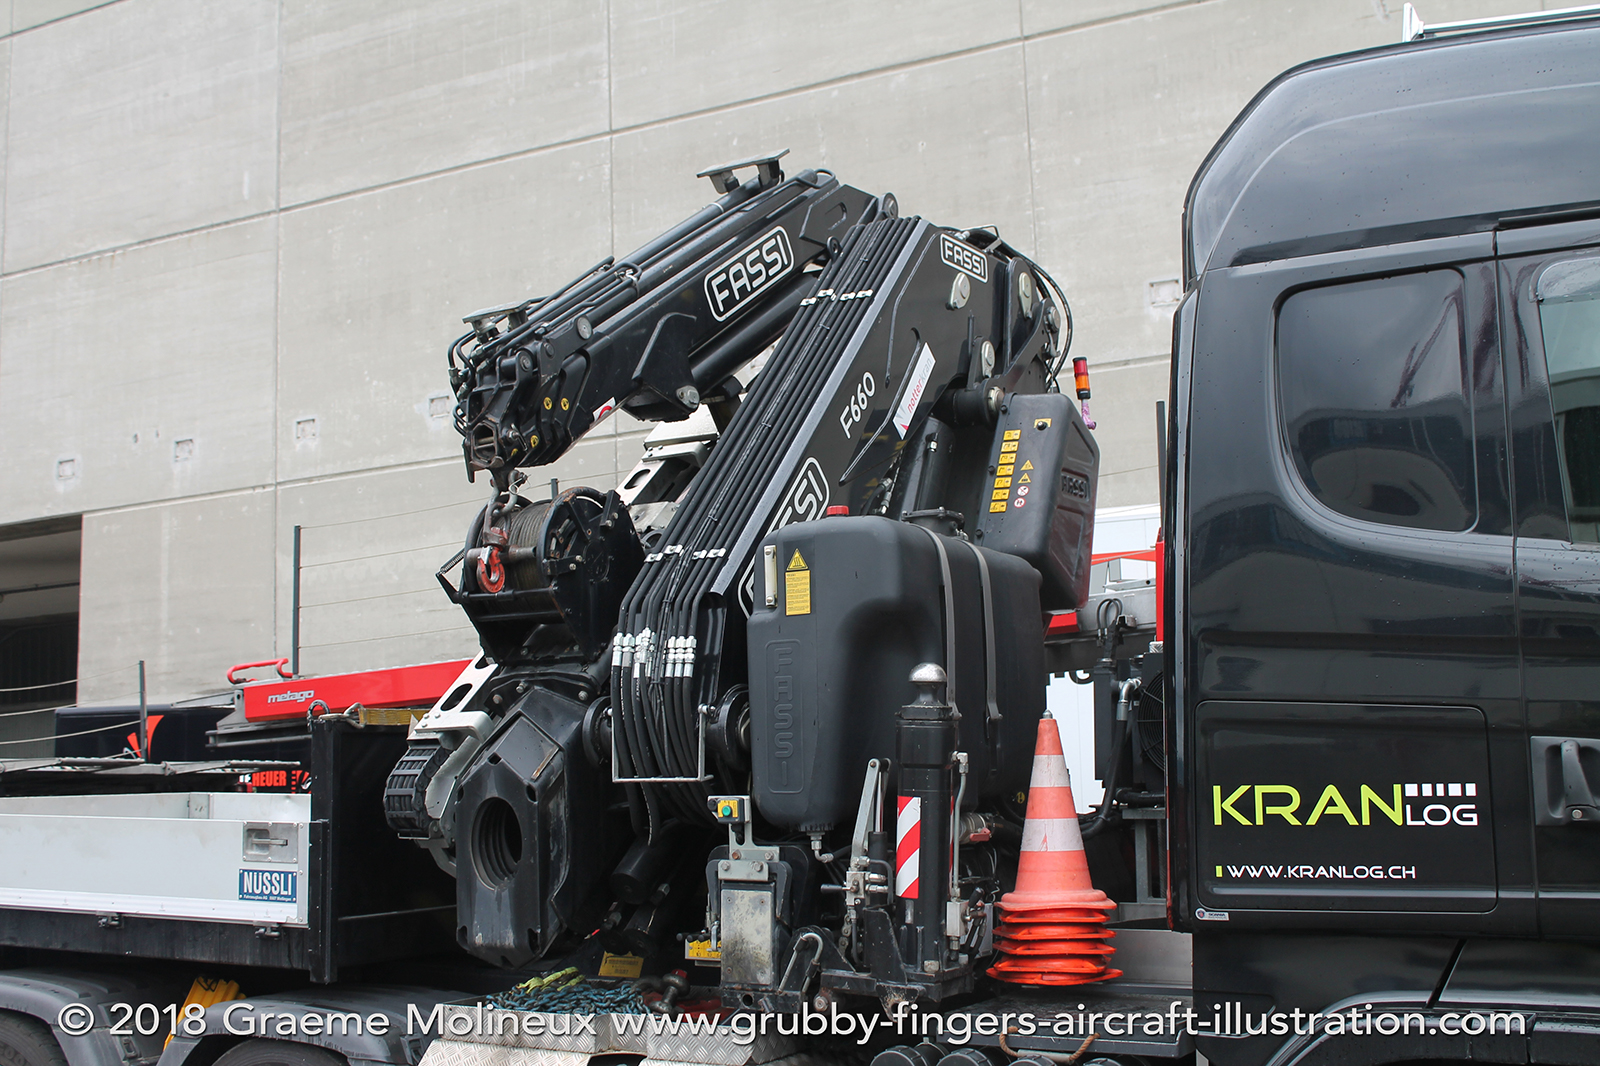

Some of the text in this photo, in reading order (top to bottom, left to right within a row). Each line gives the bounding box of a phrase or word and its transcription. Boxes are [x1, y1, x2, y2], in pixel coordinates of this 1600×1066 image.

[710, 233, 788, 312] FASSI
[944, 242, 986, 277] FASSI
[839, 371, 876, 440] F660
[1061, 474, 1089, 500] FASSI
[267, 689, 315, 704] metago
[773, 647, 794, 787] FASSI
[251, 770, 287, 788] HEUER
[1226, 864, 1417, 880] WWW.KRANLOG.CH
